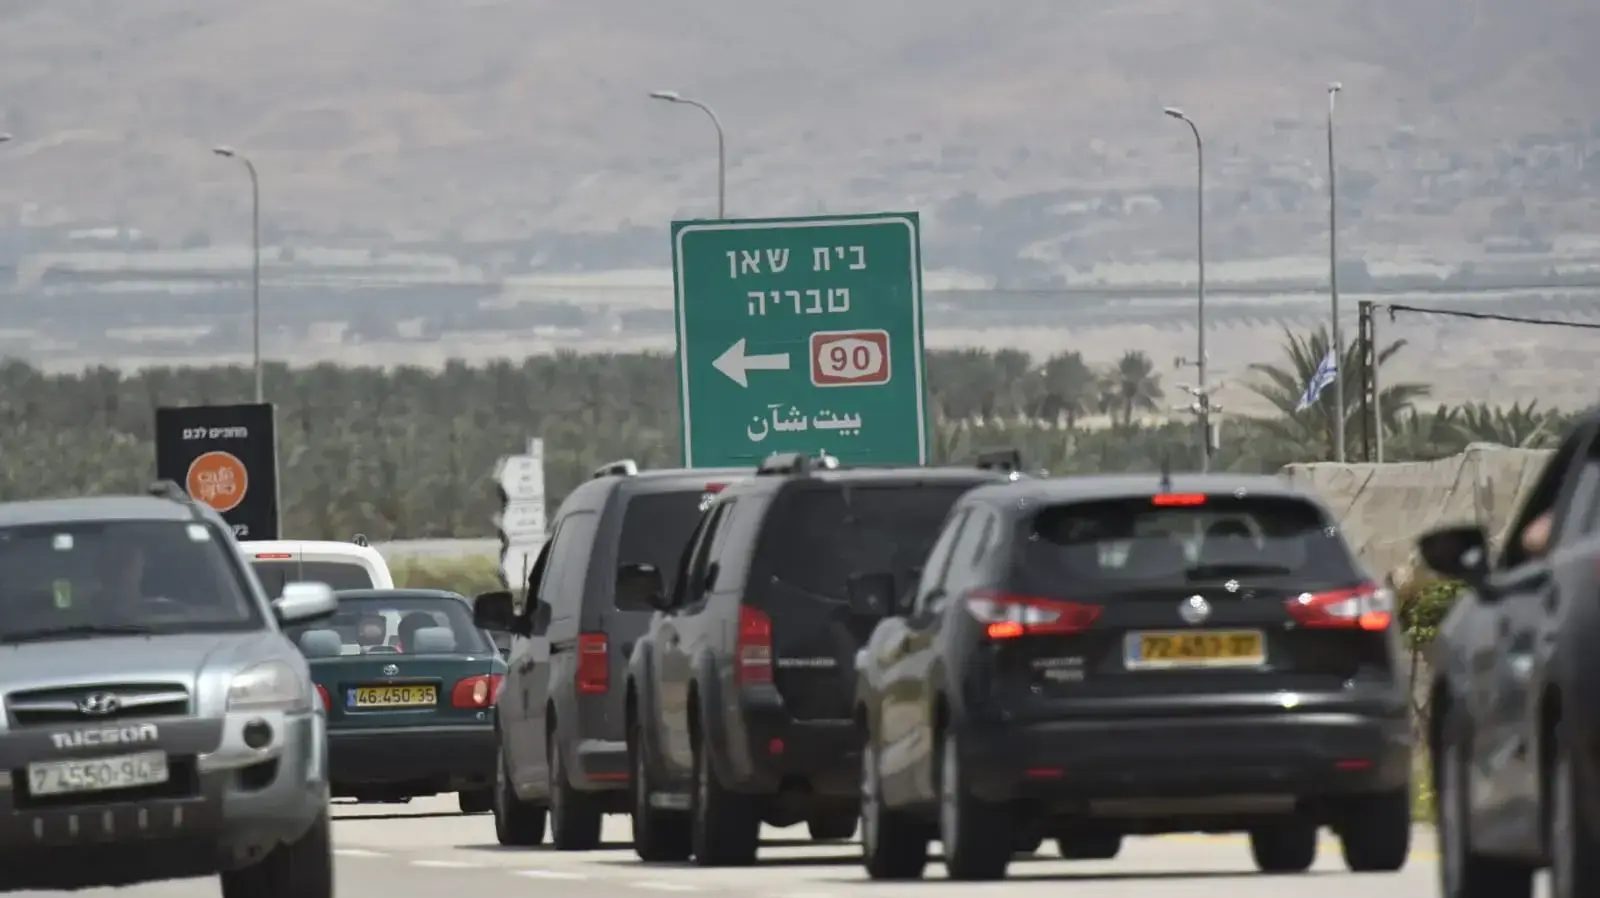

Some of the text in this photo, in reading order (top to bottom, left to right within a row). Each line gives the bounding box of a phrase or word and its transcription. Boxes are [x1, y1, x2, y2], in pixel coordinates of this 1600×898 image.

[726, 246, 867, 279] בית שאן
[747, 287, 851, 316] טבריה
[829, 345, 871, 372] 90
[813, 409, 863, 436] بيت
